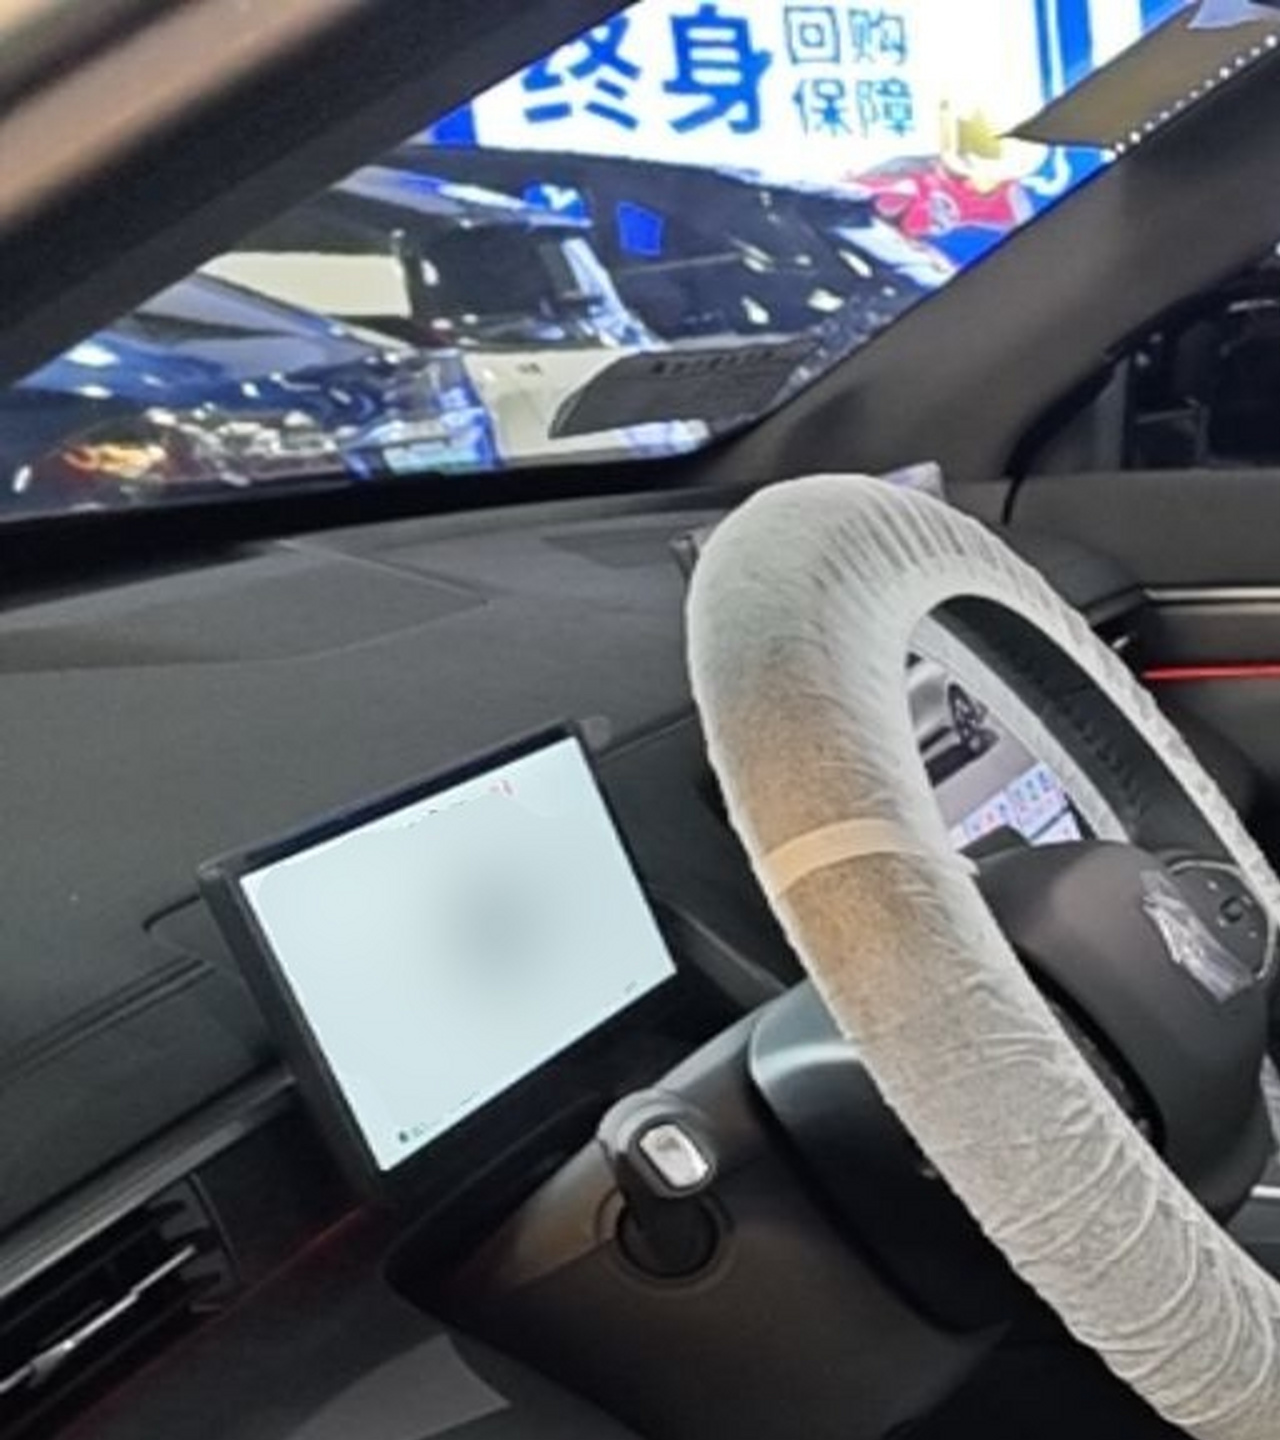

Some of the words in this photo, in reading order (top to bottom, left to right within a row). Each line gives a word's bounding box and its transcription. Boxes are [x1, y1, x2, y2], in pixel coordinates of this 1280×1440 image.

[783, 4, 909, 66] 回购
[522, 2, 773, 134] 终身
[791, 76, 916, 139] 保障
